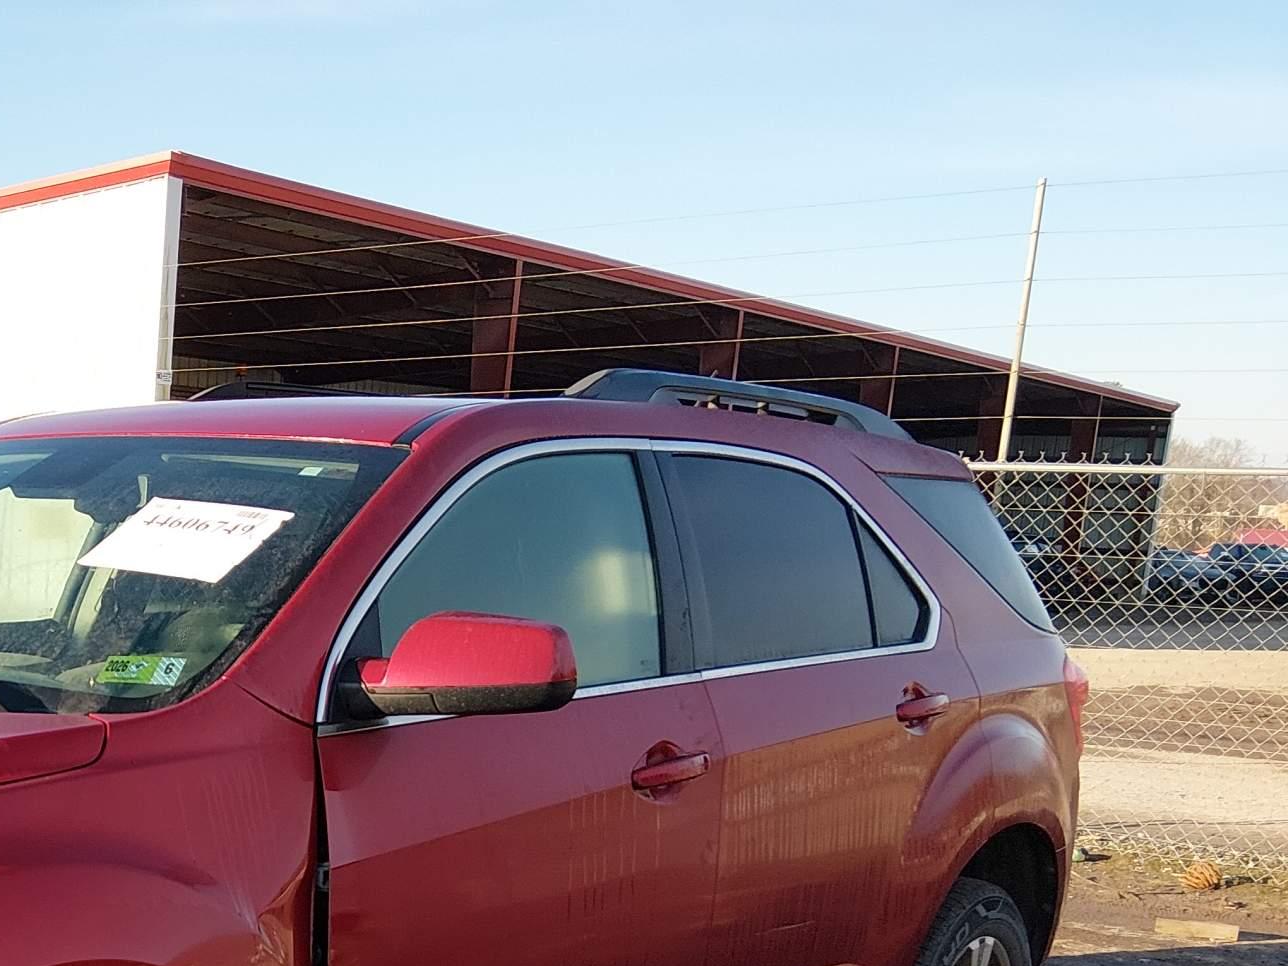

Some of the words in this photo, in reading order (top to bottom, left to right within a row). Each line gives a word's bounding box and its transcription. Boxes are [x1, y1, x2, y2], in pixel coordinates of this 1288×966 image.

[143, 515, 255, 535] 44606749
[105, 660, 130, 672] 2026
[164, 663, 175, 675] 6
